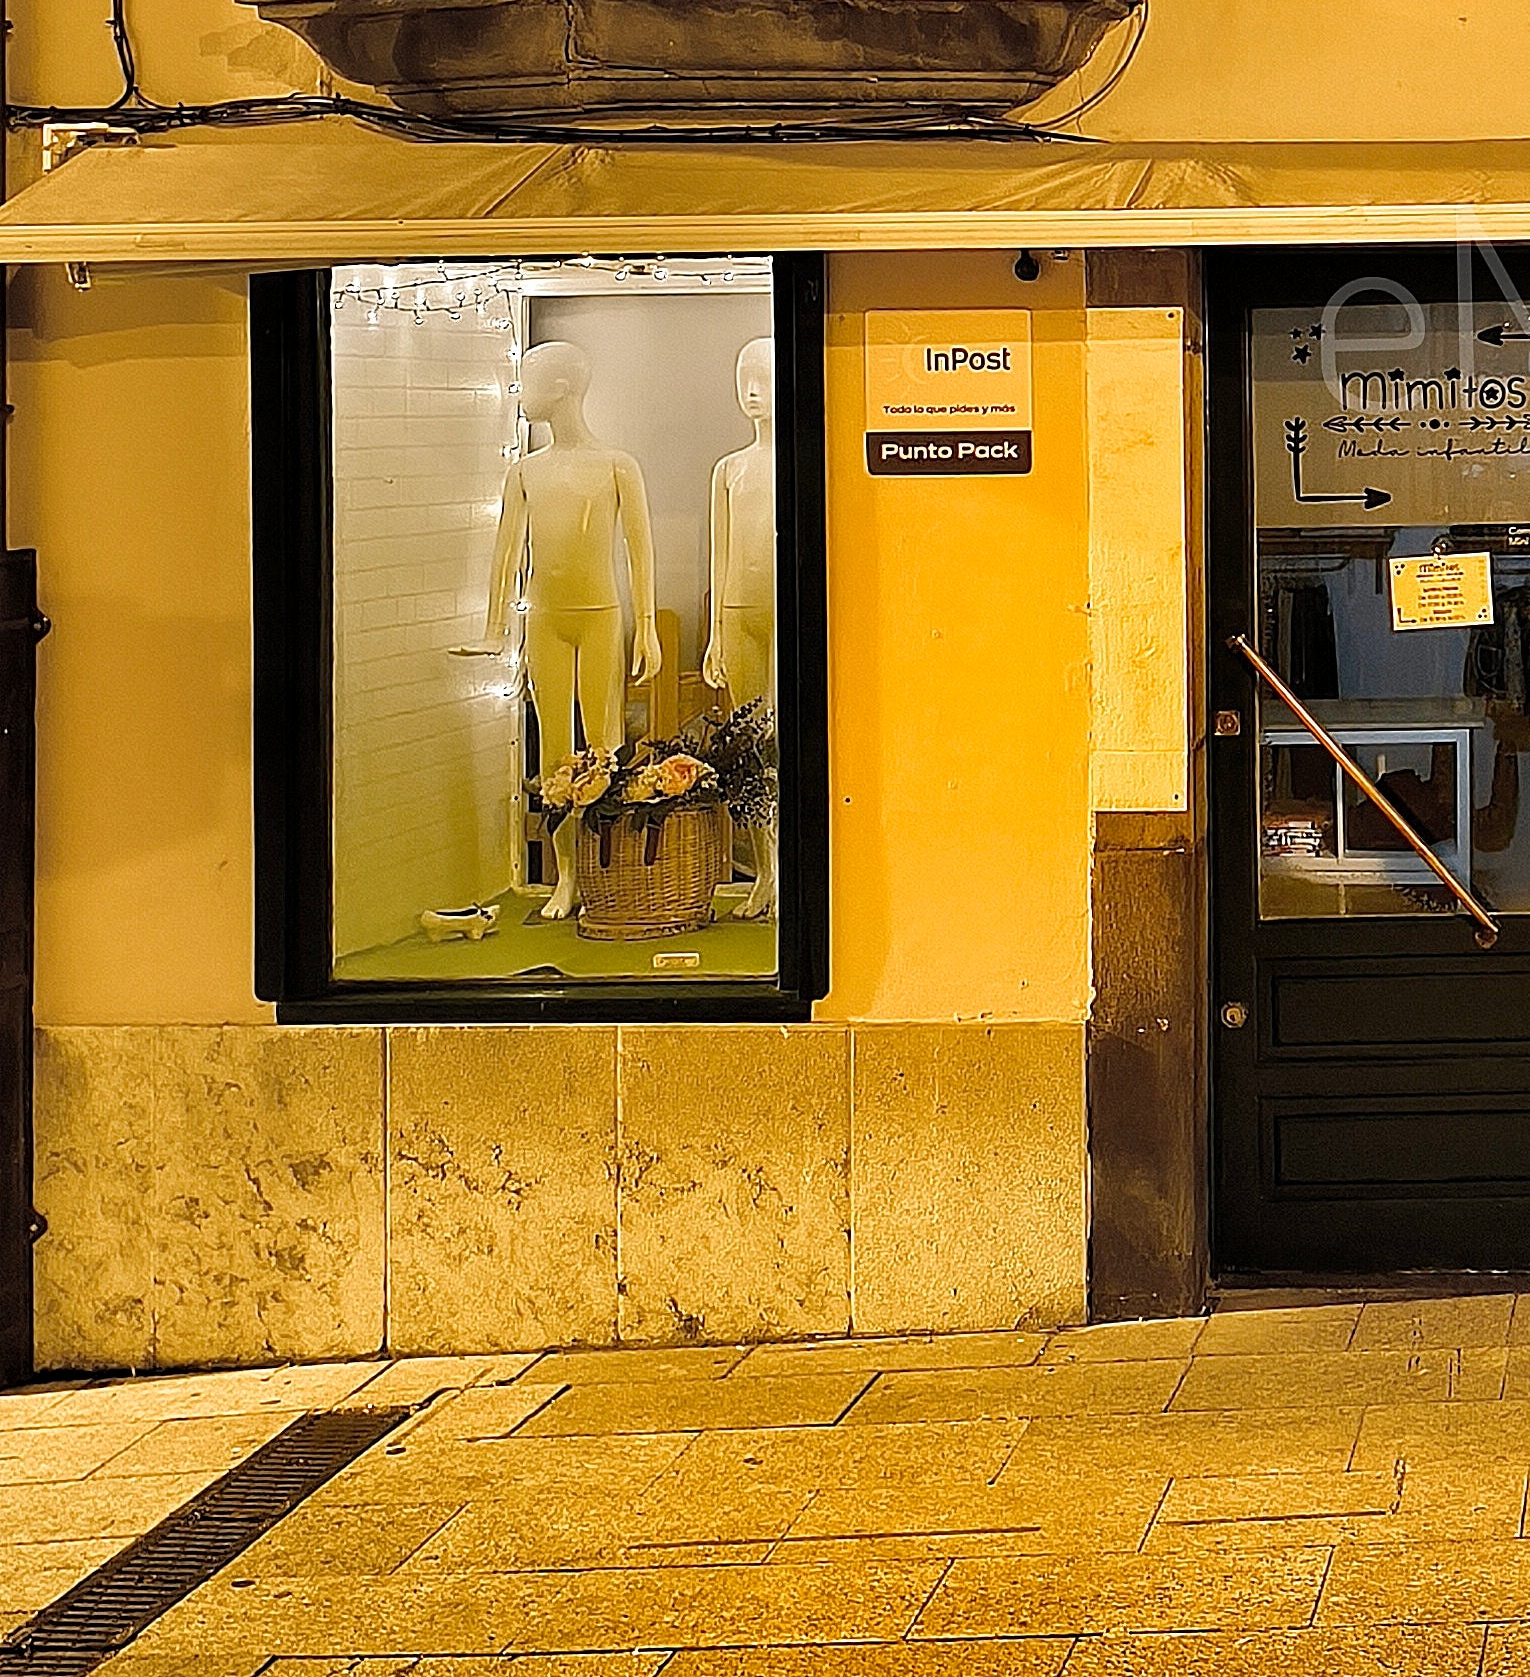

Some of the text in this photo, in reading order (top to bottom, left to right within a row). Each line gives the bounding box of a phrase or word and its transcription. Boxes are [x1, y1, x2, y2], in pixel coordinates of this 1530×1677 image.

[926, 347, 1011, 371] InPost
[1340, 366, 1527, 411] mimitos
[883, 405, 912, 414] Todo
[914, 404, 925, 414] lo
[926, 405, 947, 415] que
[949, 404, 979, 415] pides
[981, 405, 989, 415] y
[881, 441, 1019, 460] Punto Pack
